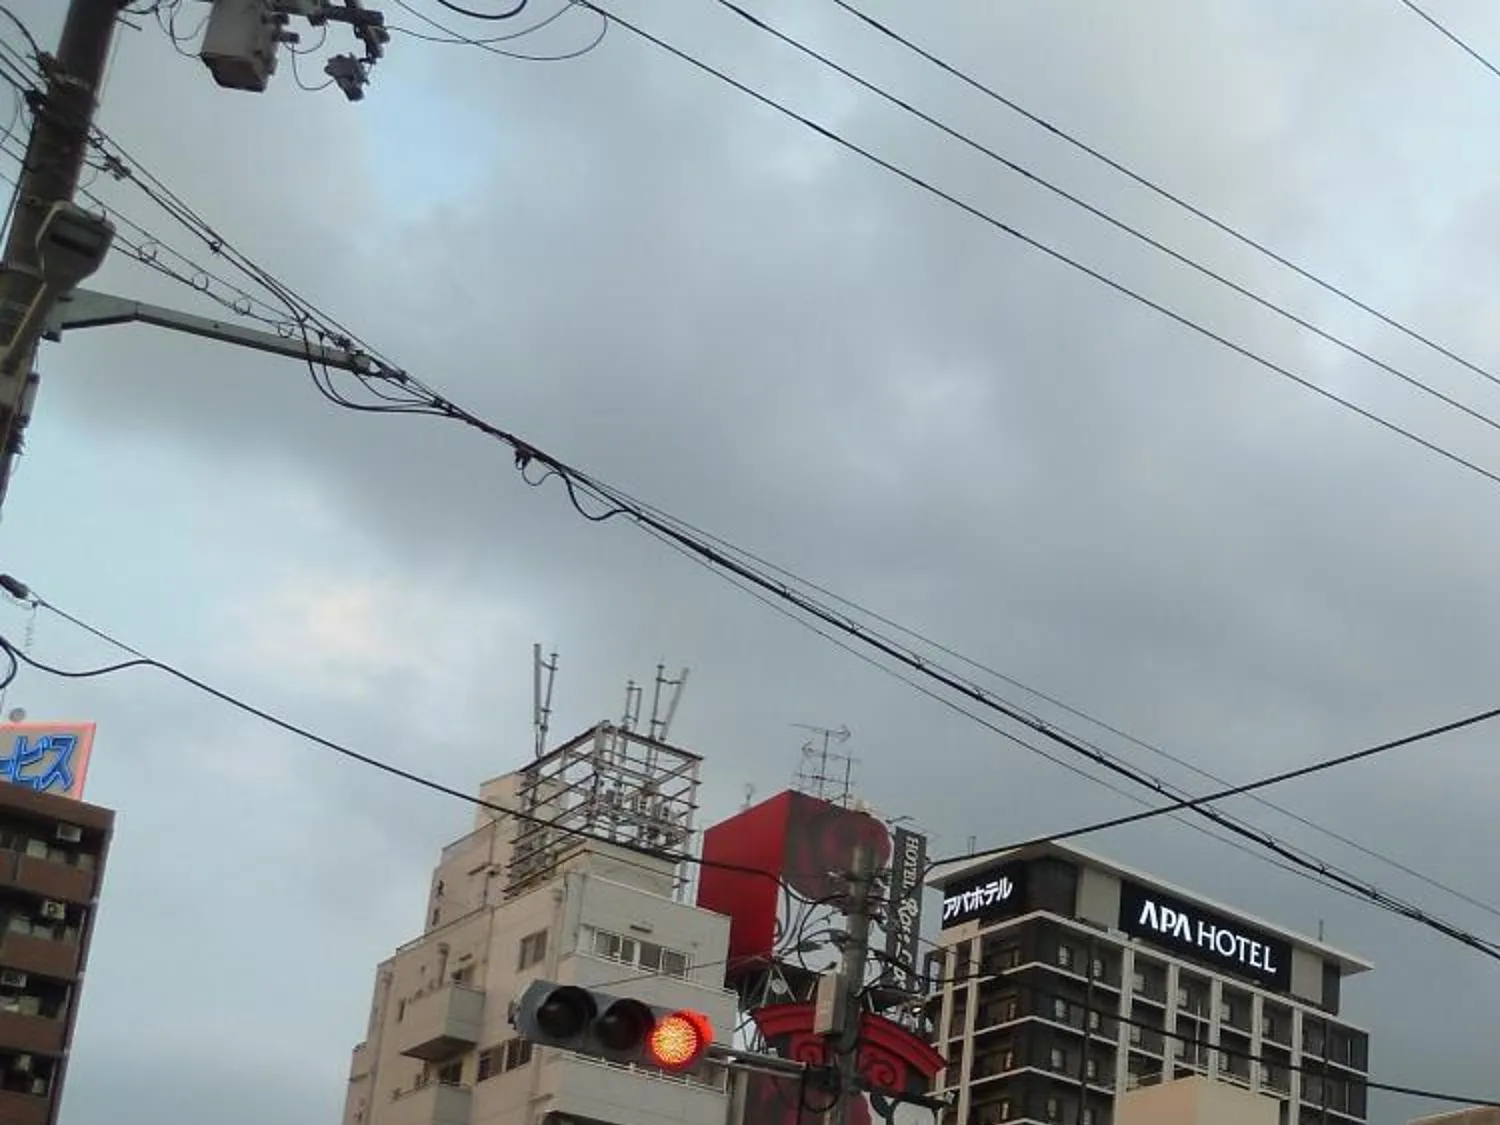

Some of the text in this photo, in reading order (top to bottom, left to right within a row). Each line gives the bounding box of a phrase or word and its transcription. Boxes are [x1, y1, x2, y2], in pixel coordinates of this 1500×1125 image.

[903, 836, 919, 889] HOTEL
[943, 876, 1013, 920] アパホテル
[1139, 899, 1277, 974] APA HOTEL
